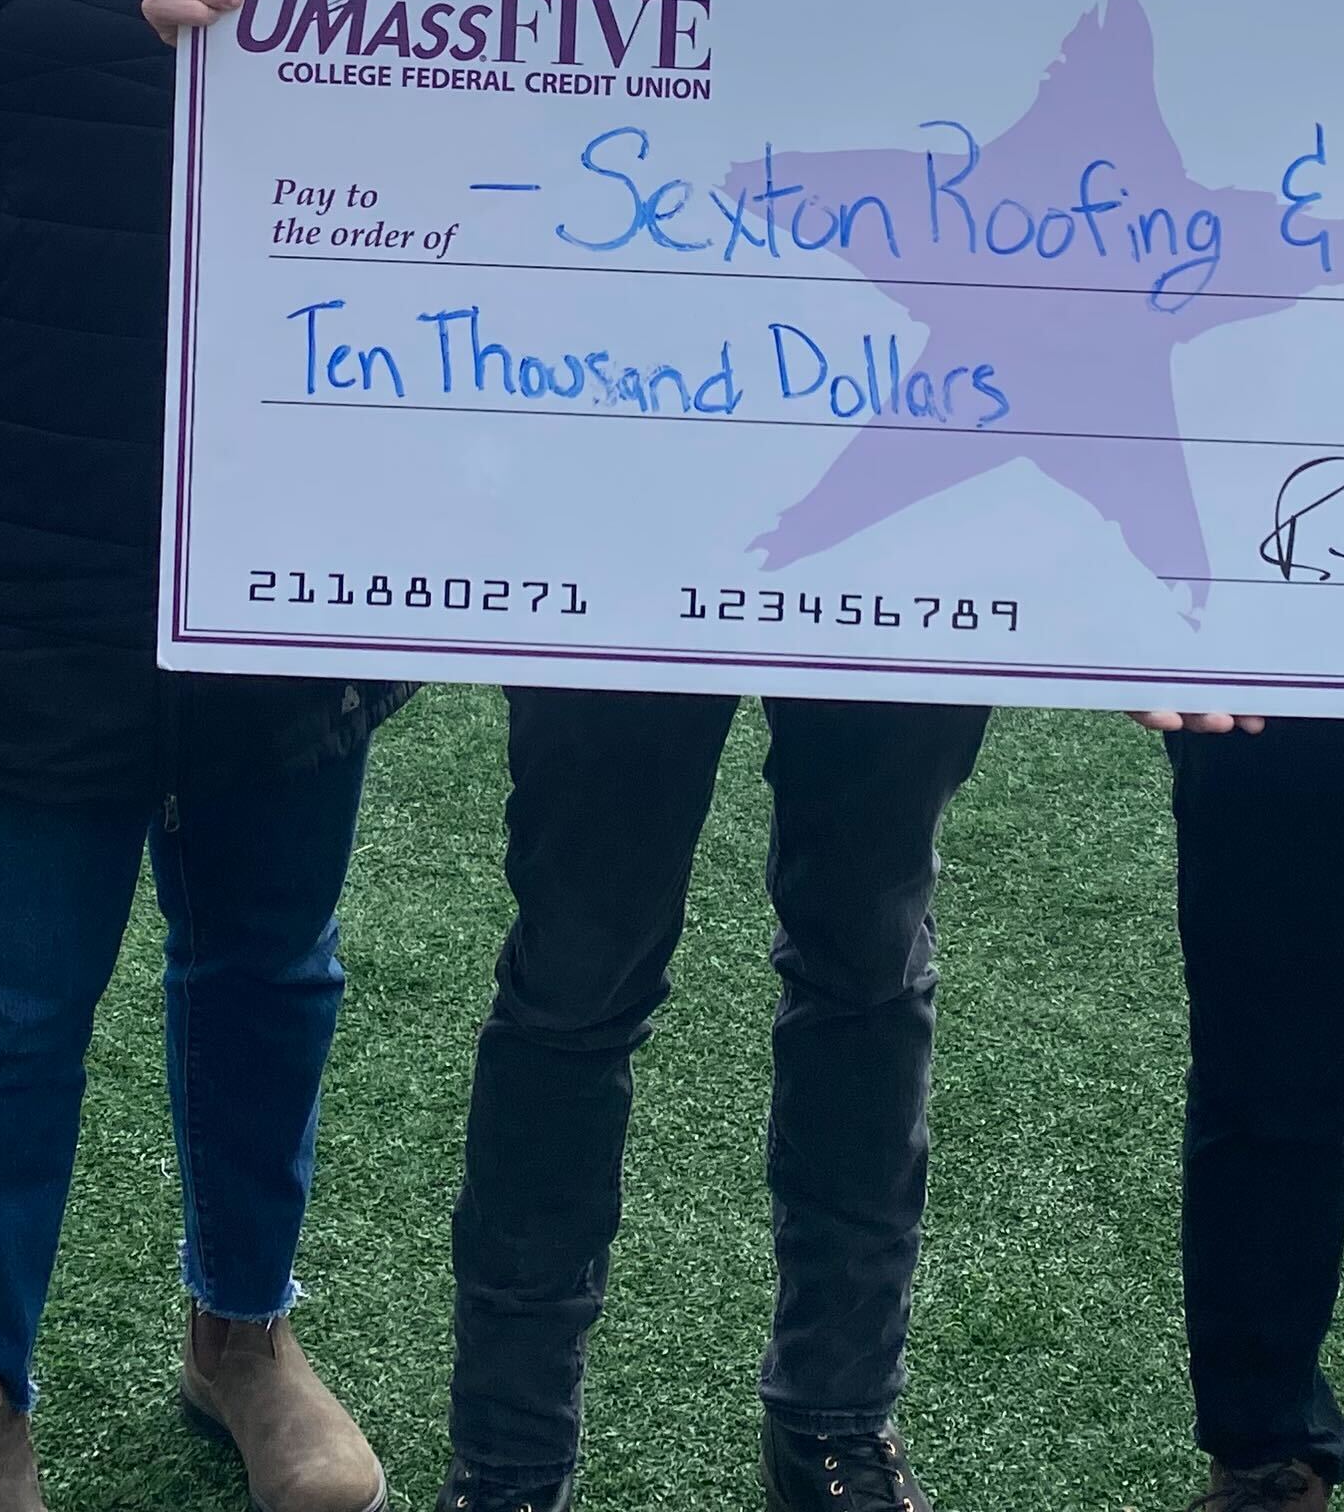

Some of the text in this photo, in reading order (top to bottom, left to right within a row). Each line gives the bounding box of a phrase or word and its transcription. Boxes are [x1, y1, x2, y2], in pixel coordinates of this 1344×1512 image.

[277, 61, 712, 101] COLLEGE FEDERAL CREDIT UNION
[272, 178, 378, 217] Pay to
[556, 125, 902, 262] Sexton
[912, 120, 1221, 313] Roofing
[1280, 123, 1331, 274] &
[271, 218, 461, 260] the order of
[287, 300, 406, 399] Ten
[416, 305, 744, 419] Thousand
[768, 322, 1025, 428] Dollars
[248, 570, 588, 615] 211880271
[679, 586, 1019, 633] 123456789
